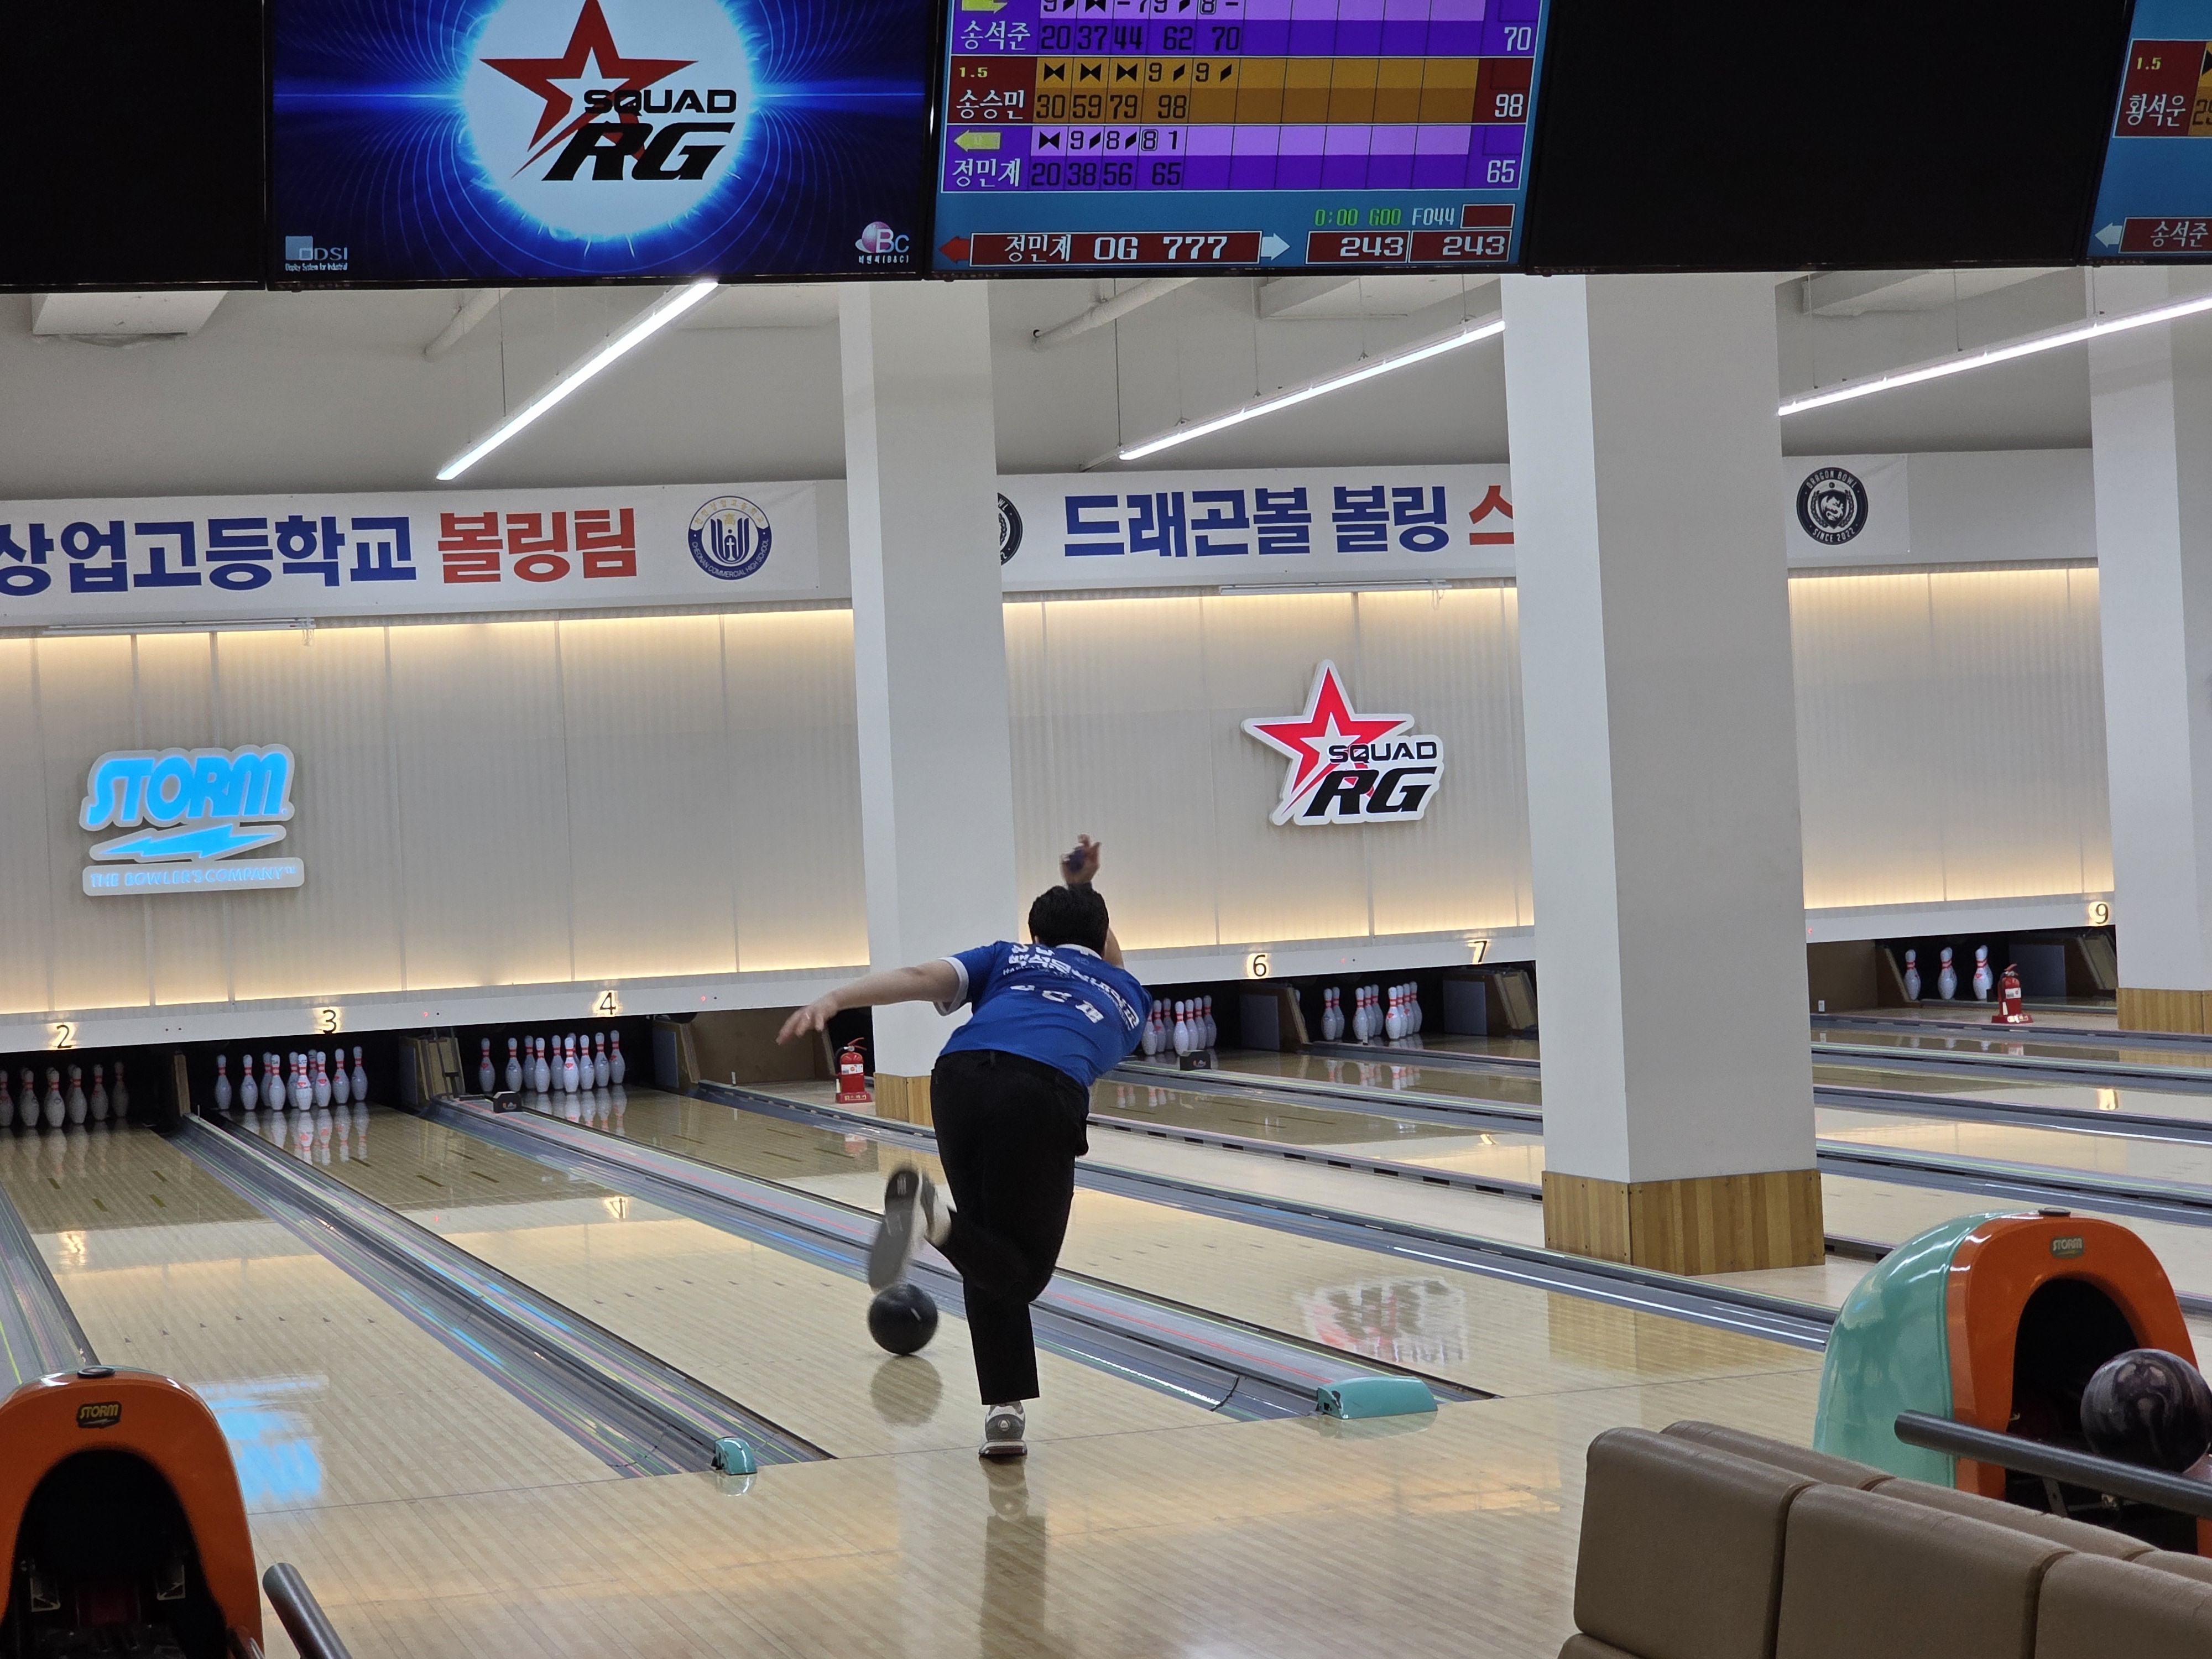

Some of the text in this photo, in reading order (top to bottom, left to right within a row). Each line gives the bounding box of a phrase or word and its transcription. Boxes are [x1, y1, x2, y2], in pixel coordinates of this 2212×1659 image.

[961, 20, 1531, 51] 송석준 20 37 44 62 70 70
[959, 67, 988, 77] 1.5
[1148, 62, 1209, 82] 9 9
[2136, 57, 2162, 70] 1.5
[584, 89, 737, 117] SQUAD
[956, 90, 1524, 119] 송승민 30 59 79 98 98
[2126, 93, 2186, 126] 황석운
[542, 122, 736, 181] RG
[1070, 131, 1177, 150] 9 8 8 1
[952, 158, 1516, 187] 정민재 20 38 56 65 65
[1315, 208, 1358, 226] 0:00
[876, 229, 909, 253] BC
[1442, 236, 1505, 255] 243
[2151, 221, 2209, 248] 송석준
[314, 247, 347, 260] DSI
[1004, 234, 1072, 262] 정민재
[1163, 236, 1228, 259] 777
[1340, 237, 1404, 257] 243
[1806, 470, 1857, 489] DRAGON BOWL
[1064, 487, 1312, 557] 드래곤볼
[1331, 485, 1449, 553] 볼링
[1812, 527, 1855, 542] SINCE 2022
[0, 508, 637, 597] 상업고등학교 볼링팀
[755, 539, 769, 562] SCHOOL
[1328, 742, 1437, 763] SQUAD
[87, 753, 288, 825] STORM
[1302, 766, 1438, 817] RG
[90, 872, 119, 887] THE
[125, 870, 202, 886] BOWLER'S
[2095, 903, 2109, 925] 9
[1472, 940, 1488, 963] 7
[1253, 954, 1267, 977] 6
[599, 992, 616, 1015] 4
[322, 1009, 337, 1034] 3
[56, 1024, 72, 1048] 2
[2052, 1238, 2083, 1251] STORM
[80, 1404, 119, 1419] STORM
